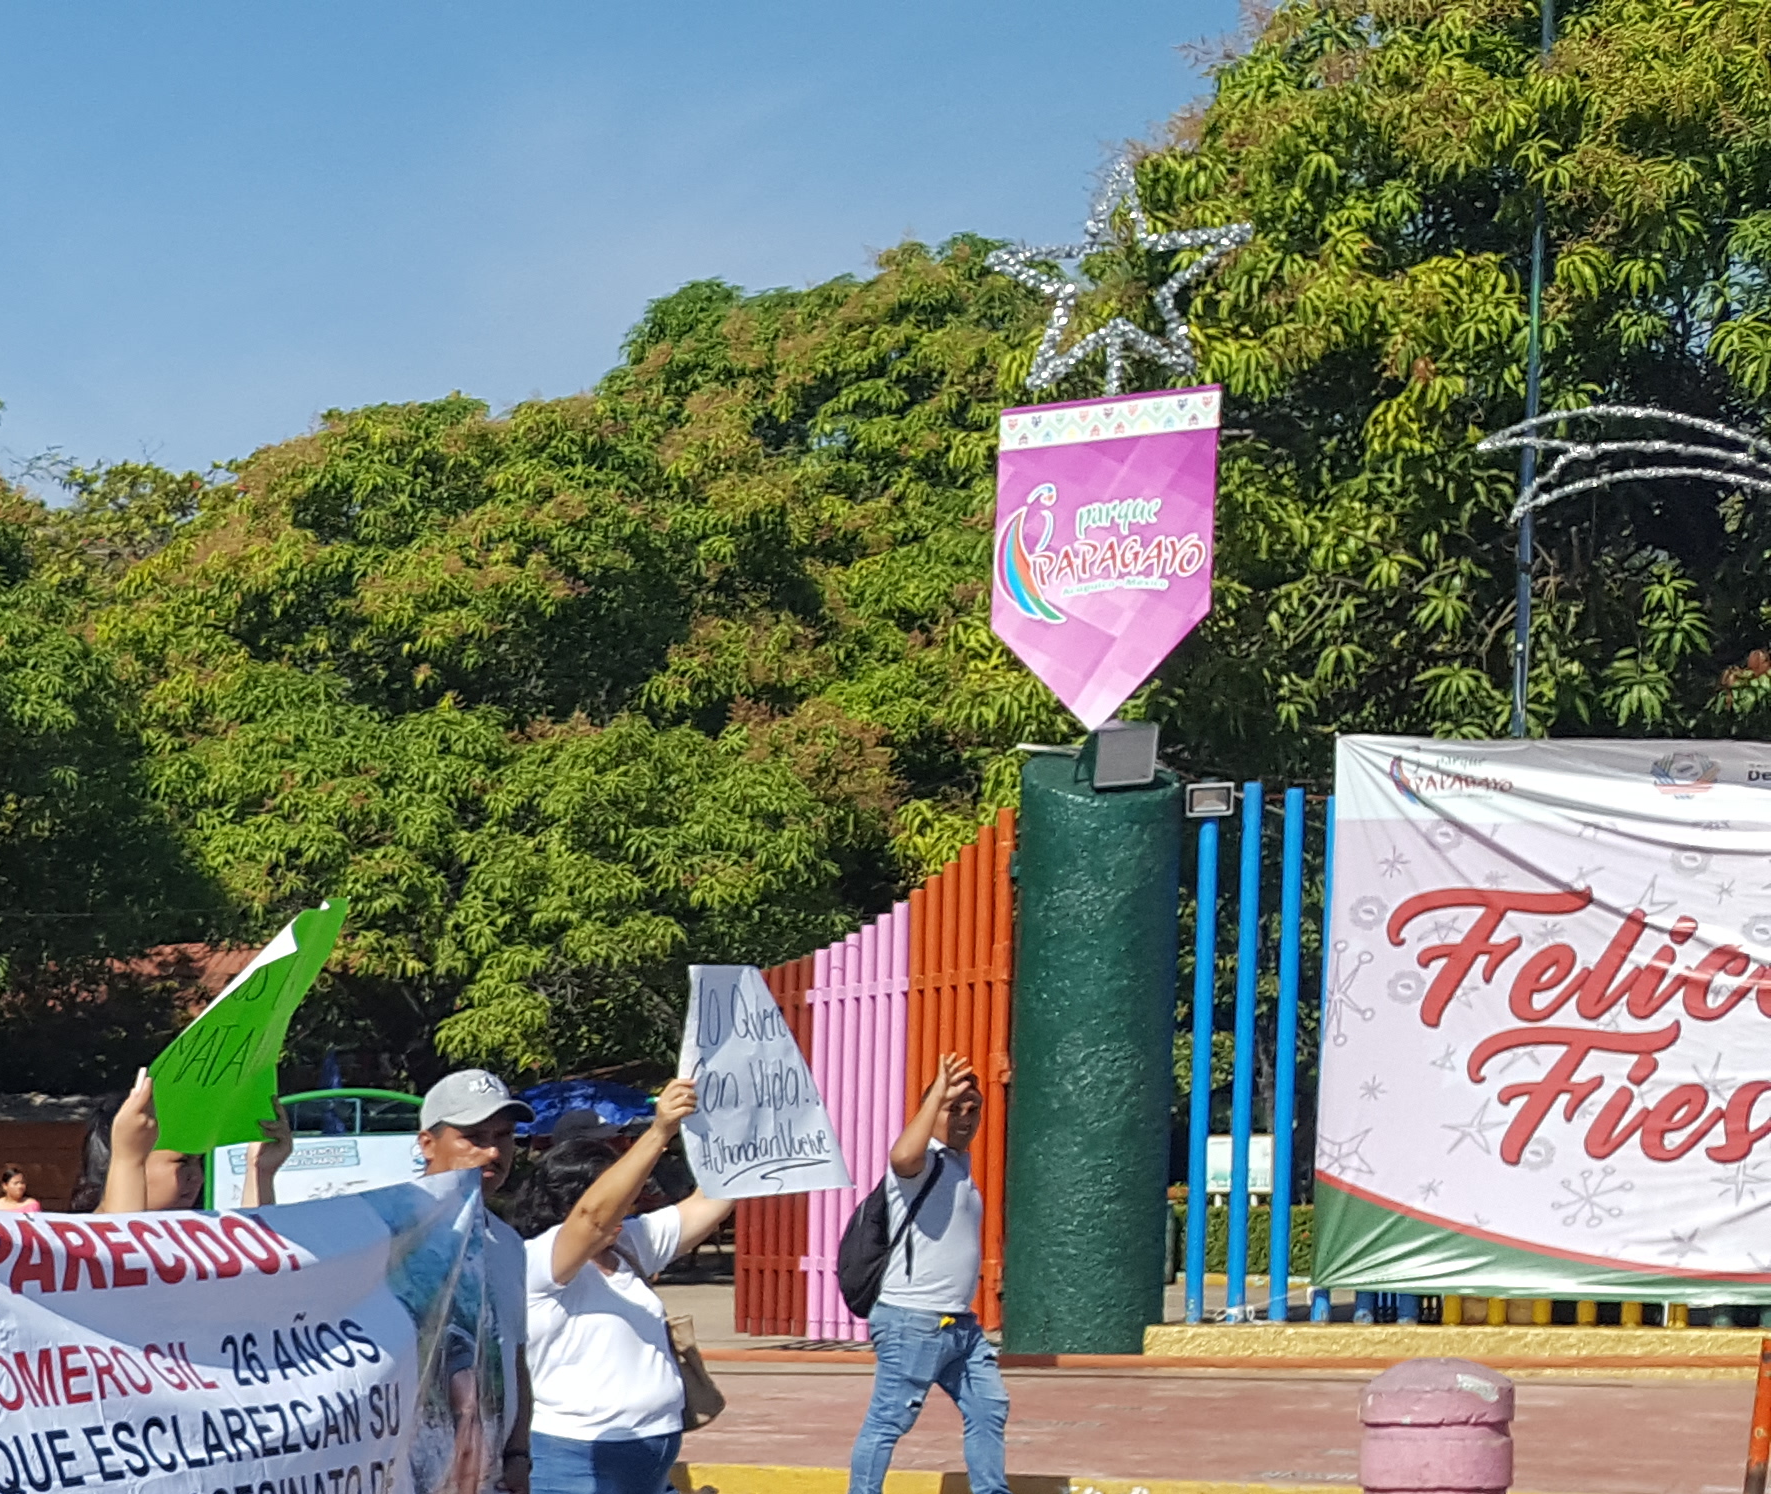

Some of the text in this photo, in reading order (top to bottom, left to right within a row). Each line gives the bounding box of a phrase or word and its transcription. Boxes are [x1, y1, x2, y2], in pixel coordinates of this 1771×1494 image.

[1078, 498, 1160, 538] parque
[1032, 535, 1206, 587] PAPAGAYO
[153, 1024, 255, 1089] MATA
[157, 1341, 219, 1391] GIL
[221, 1332, 270, 1386] 26
[272, 1311, 381, 1381] AÑOS
[85, 1389, 363, 1483] ESCLAREZCAN
[368, 1382, 400, 1440] SU
